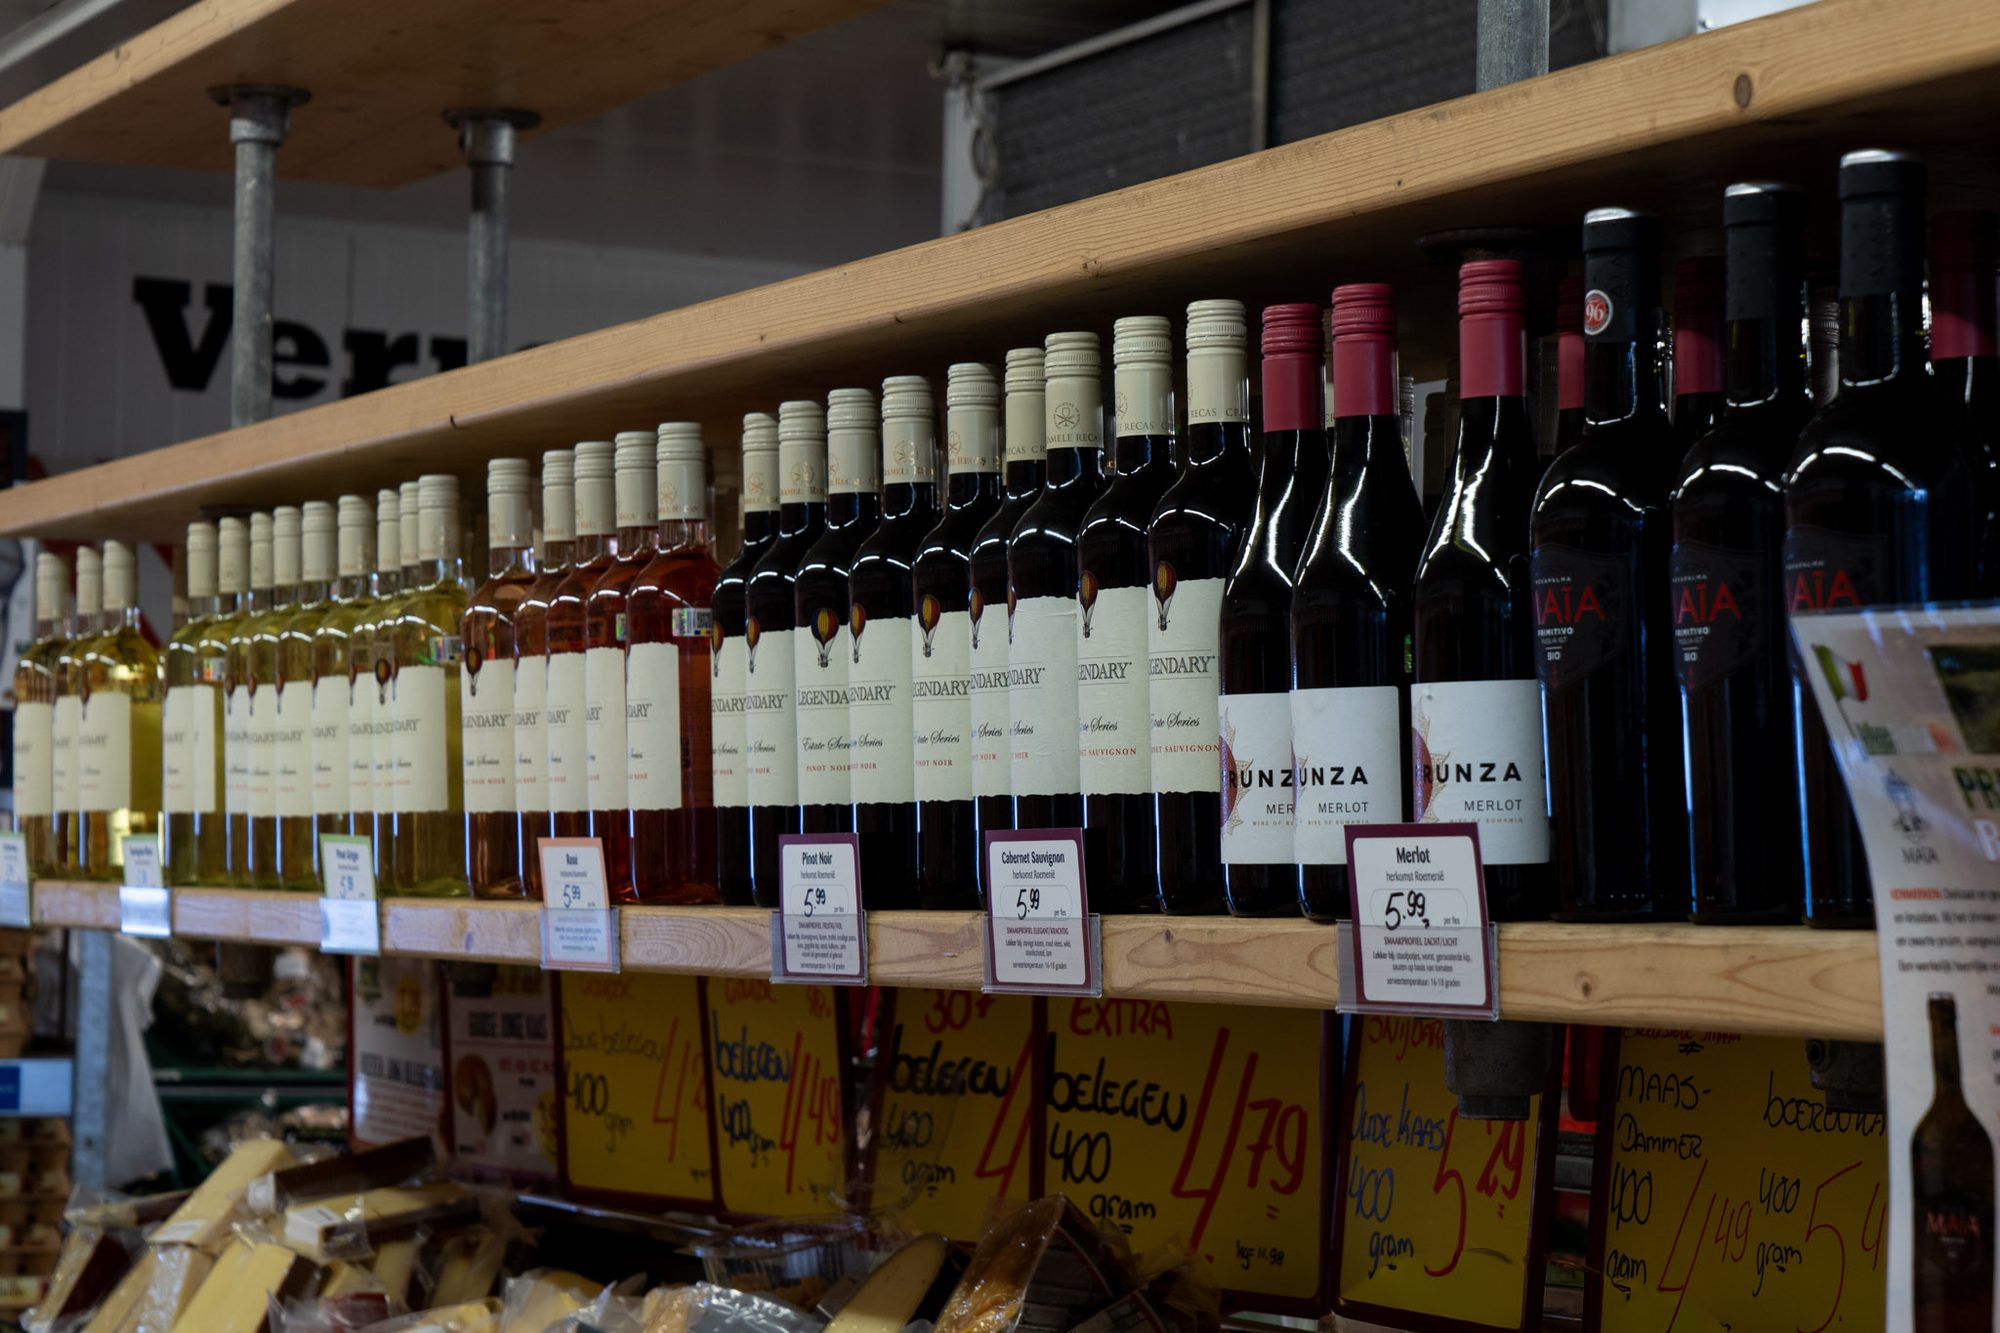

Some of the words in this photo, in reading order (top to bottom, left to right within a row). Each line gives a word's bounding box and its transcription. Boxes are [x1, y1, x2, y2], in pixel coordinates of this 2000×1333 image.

[1125, 421, 1154, 430] RECAS
[1091, 716, 1118, 734] Series
[1167, 711, 1200, 730] Series
[930, 729, 960, 746] Series
[1089, 748, 1137, 757] SAUVIGNON
[1165, 744, 1220, 754] SAUVIGNON
[933, 759, 953, 767] NOIR
[1318, 801, 1369, 814] MERLOT
[1463, 799, 1523, 812] MERLOT
[802, 851, 818, 866] Pinot
[819, 851, 833, 865] Noir
[1002, 851, 1030, 865] Cabernet
[1031, 851, 1065, 867] Sauvignon
[1396, 845, 1431, 864] Merlot
[1386, 870, 1414, 881] herkomst
[804, 887, 826, 918] 5.99
[1017, 888, 1040, 921] 5.99
[1050, 1122, 1111, 1184] 400
[1349, 1154, 1394, 1222] 400
[1611, 1161, 1652, 1230] 400
[1759, 1167, 1801, 1215] 400
[1368, 1231, 1414, 1280] gram
[1752, 1241, 1803, 1298] gram
